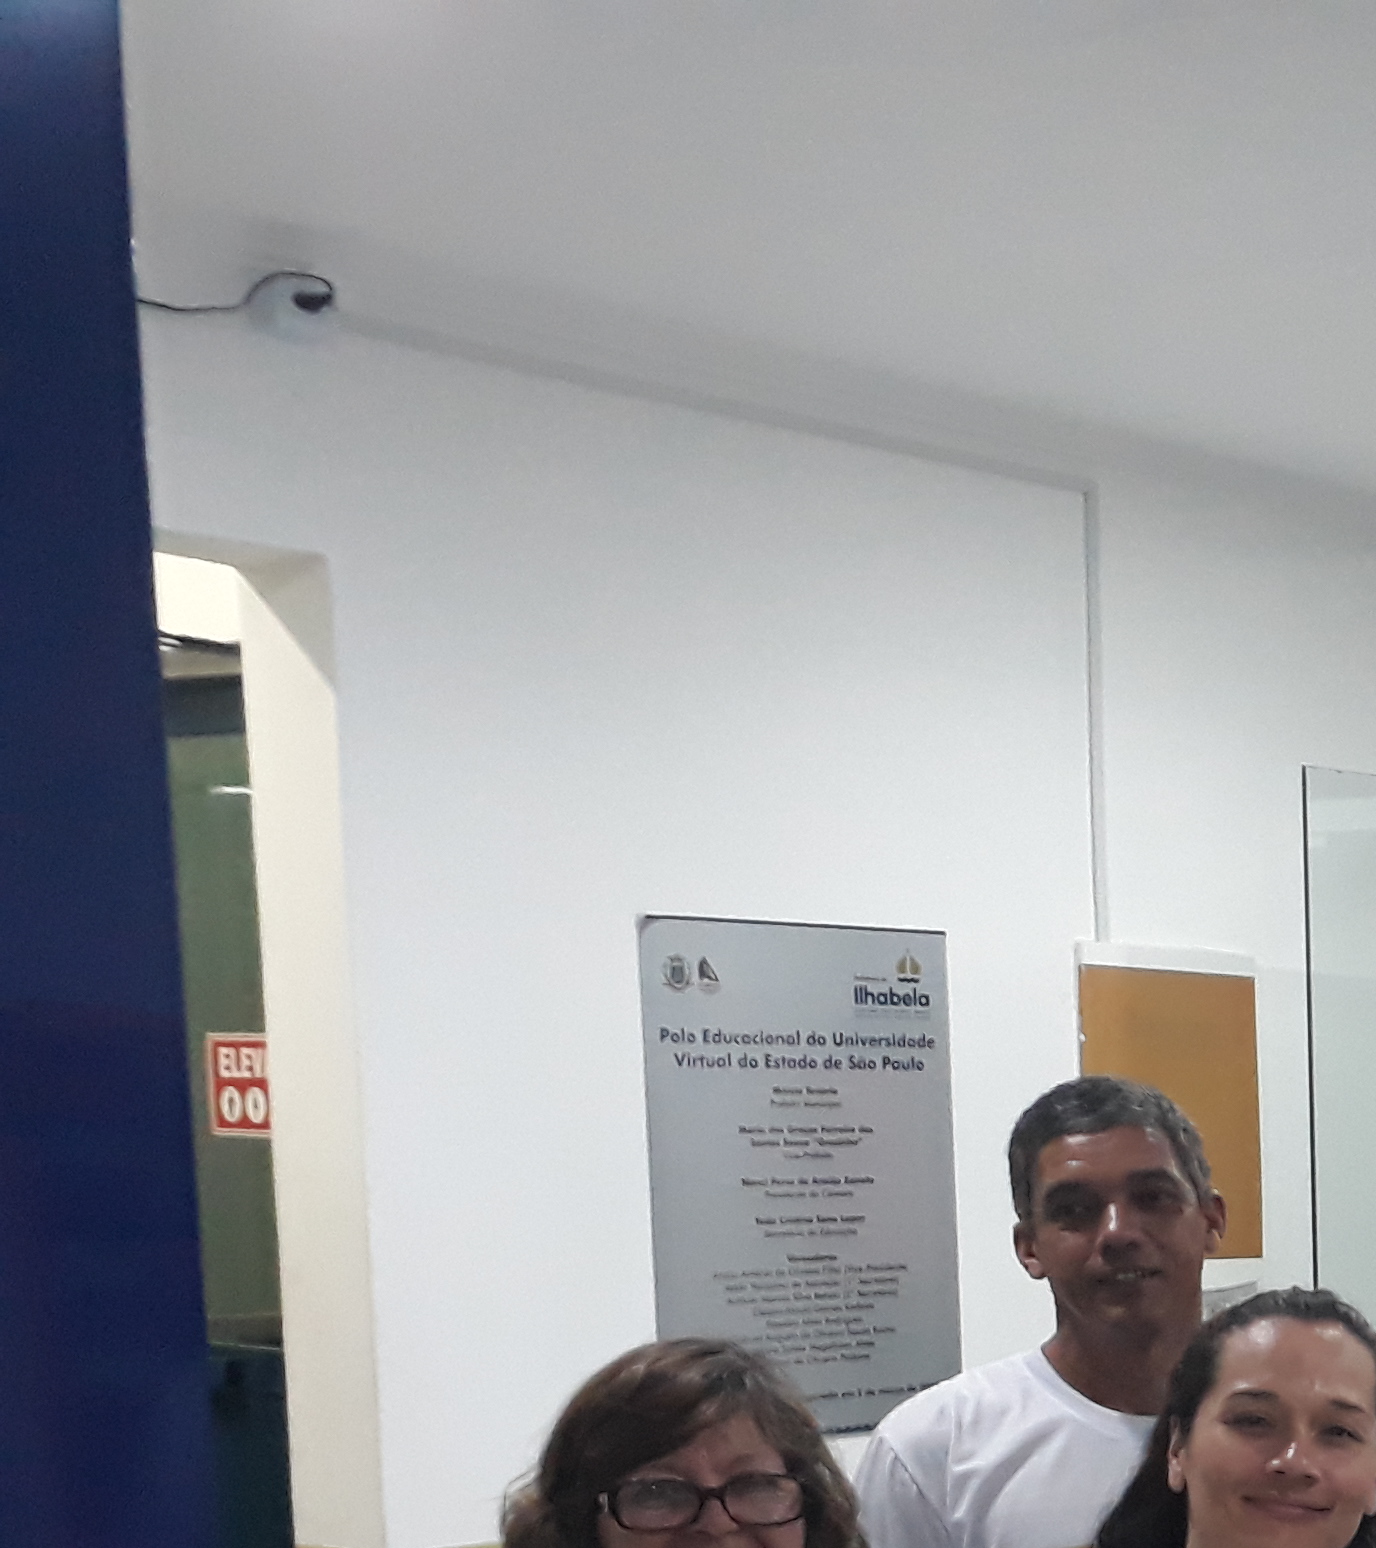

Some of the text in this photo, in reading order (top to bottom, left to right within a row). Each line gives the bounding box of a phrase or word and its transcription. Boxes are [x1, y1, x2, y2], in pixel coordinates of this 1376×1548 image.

[854, 985, 930, 1007] Ilhabela
[659, 1027, 696, 1043] Polo
[702, 1027, 800, 1046] Educacional
[832, 1031, 936, 1049] Universidade
[673, 1052, 732, 1068] Virtual
[764, 1053, 818, 1070] Estado
[823, 1053, 842, 1070] de
[882, 1055, 925, 1072] Paulo
